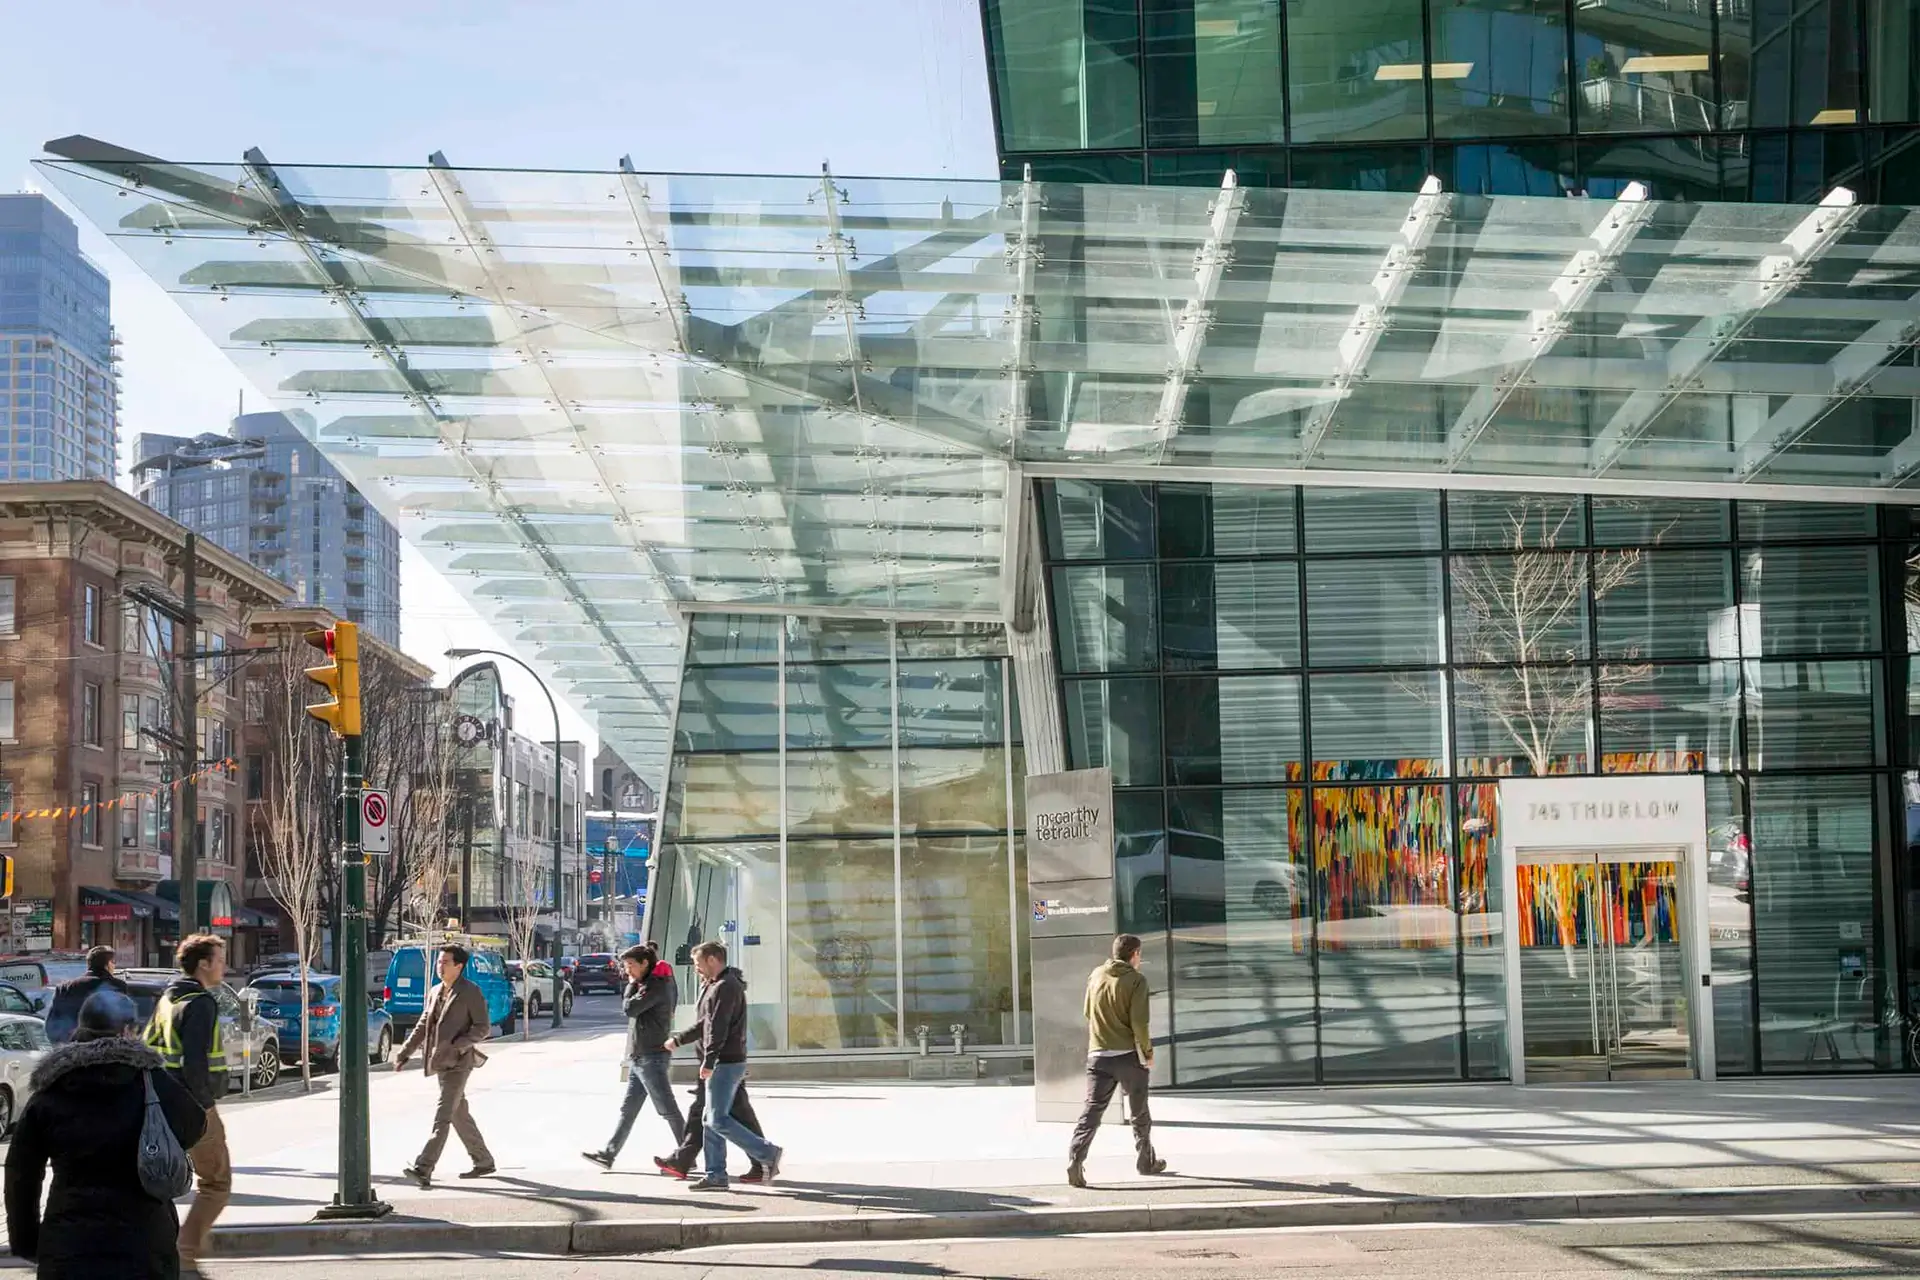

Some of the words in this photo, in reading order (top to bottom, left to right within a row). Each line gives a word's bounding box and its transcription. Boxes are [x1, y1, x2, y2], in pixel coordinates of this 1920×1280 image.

[1036, 805, 1100, 827] mccarthy
[1528, 802, 1561, 820] 745
[1569, 801, 1679, 820] THURLOW
[1035, 822, 1089, 841] tetrault
[1719, 927, 1740, 940] 745
